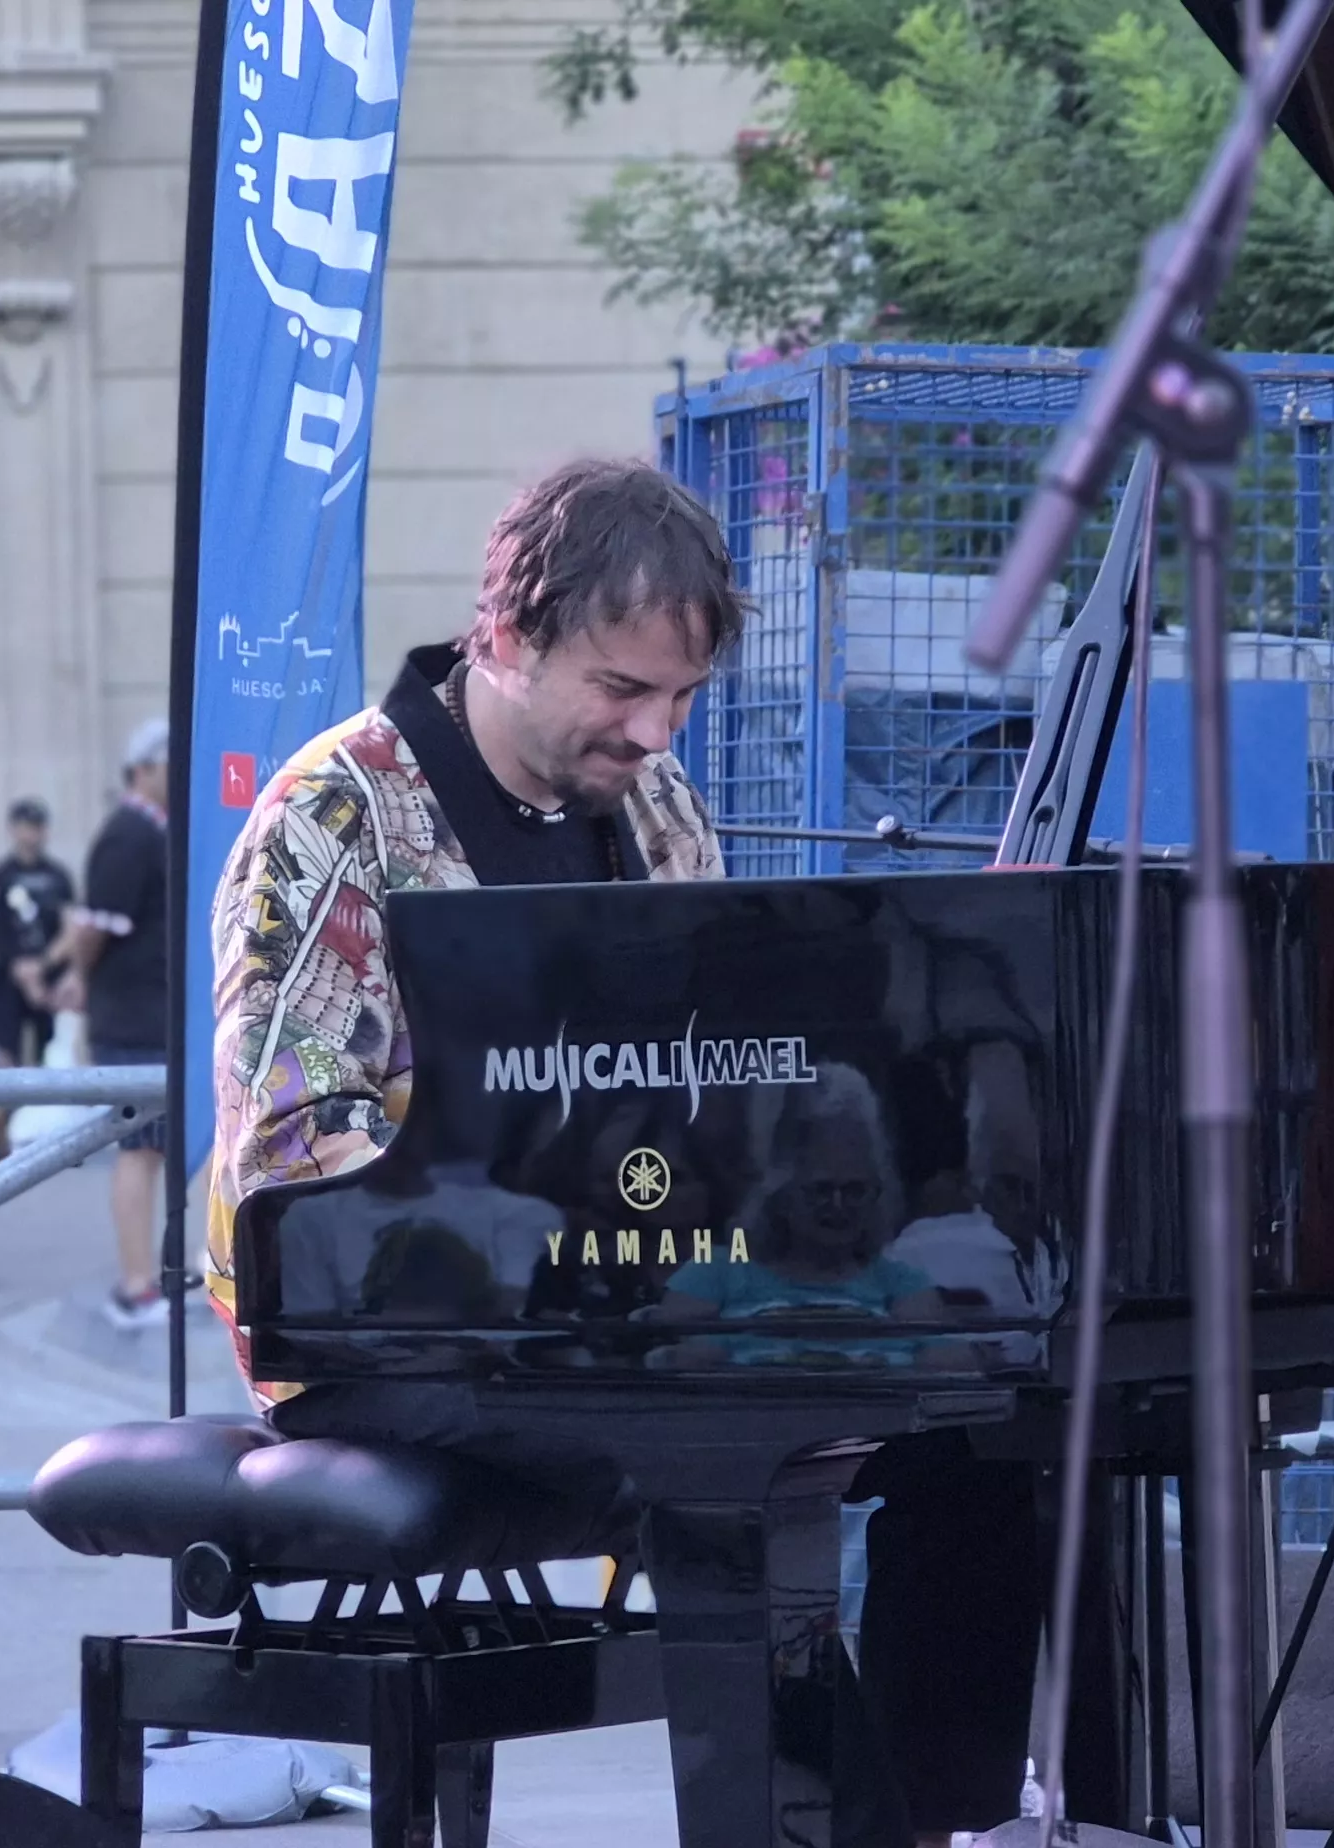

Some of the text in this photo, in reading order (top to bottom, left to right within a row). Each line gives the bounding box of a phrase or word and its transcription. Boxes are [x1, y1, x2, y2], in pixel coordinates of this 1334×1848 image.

[231, 677, 327, 699] HUESC JA
[545, 1227, 750, 1266] YAMAHA
